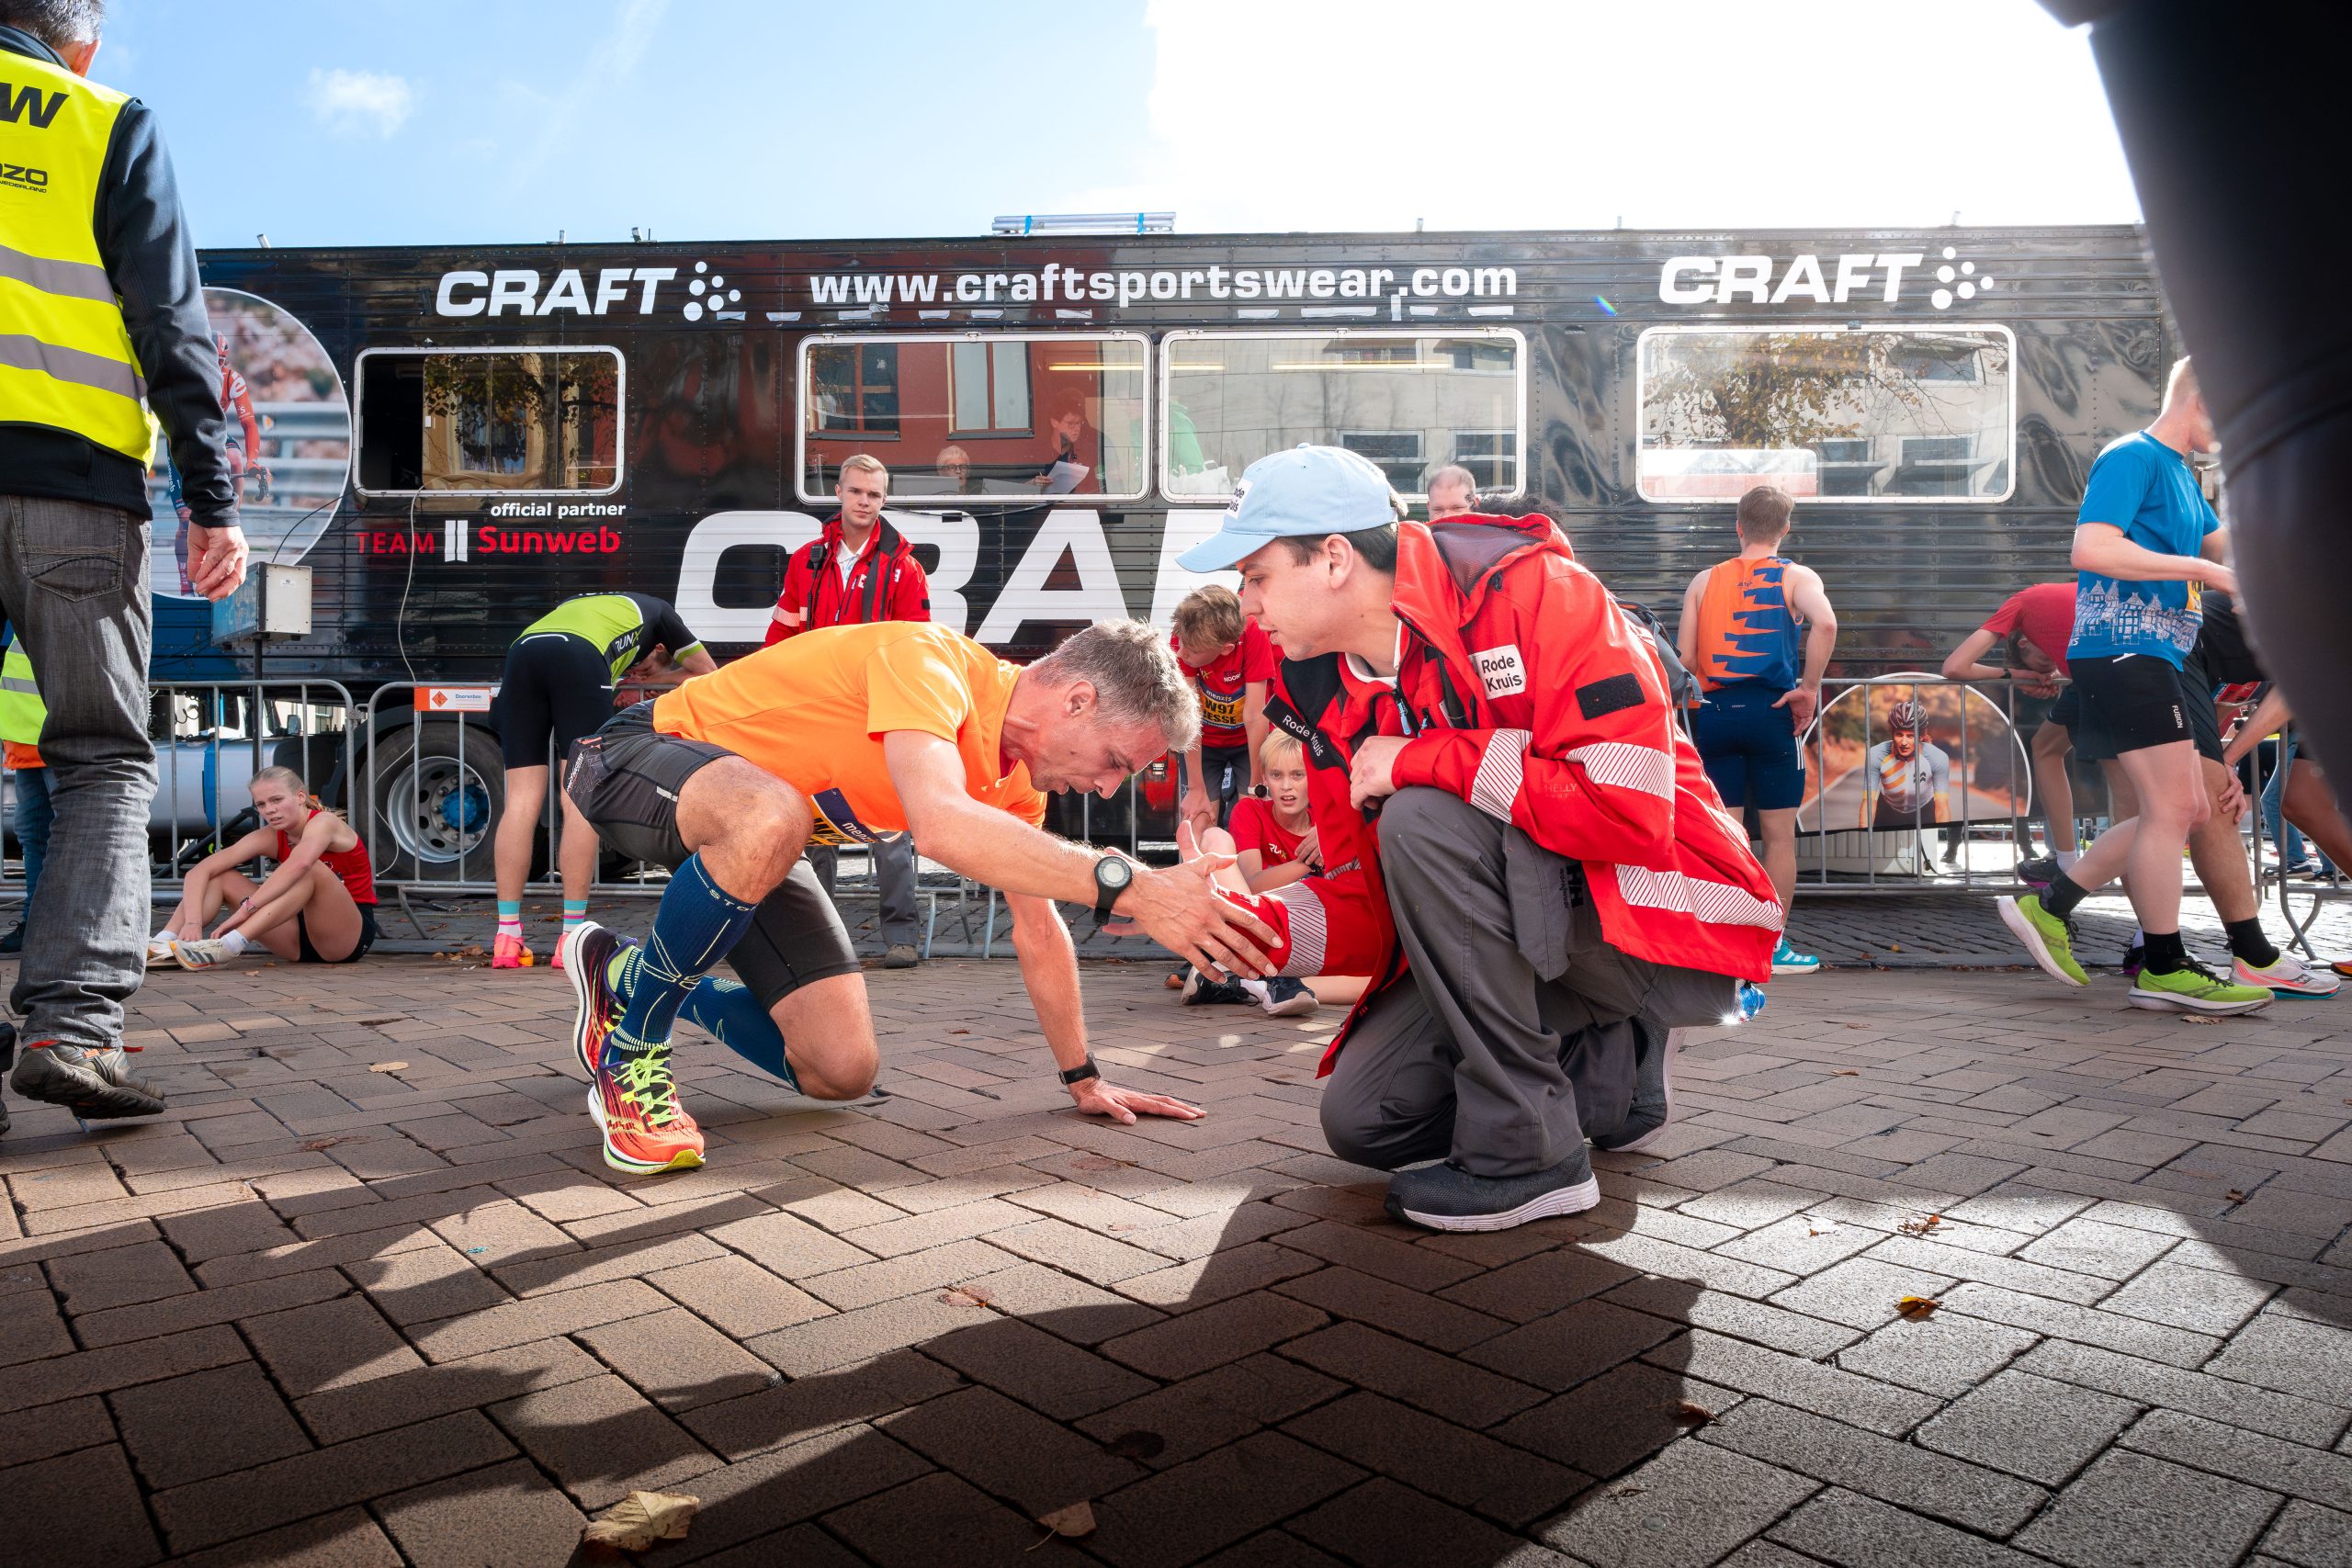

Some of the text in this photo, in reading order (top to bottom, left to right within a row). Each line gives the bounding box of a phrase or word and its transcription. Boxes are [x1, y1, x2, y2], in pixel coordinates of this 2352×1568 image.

[809, 263, 1517, 308] www.craftsportswear.com
[1658, 253, 1924, 304] CRAFT
[436, 267, 678, 317] CRAFT
[490, 502, 627, 519] official partner
[354, 525, 621, 555] TEAM Sunweb
[1481, 655, 1515, 673] Rode
[1485, 672, 1523, 693] Kruis
[1204, 698, 1235, 716] W97
[2171, 705, 2184, 728] FUSION
[1283, 715, 1310, 738] Rode
